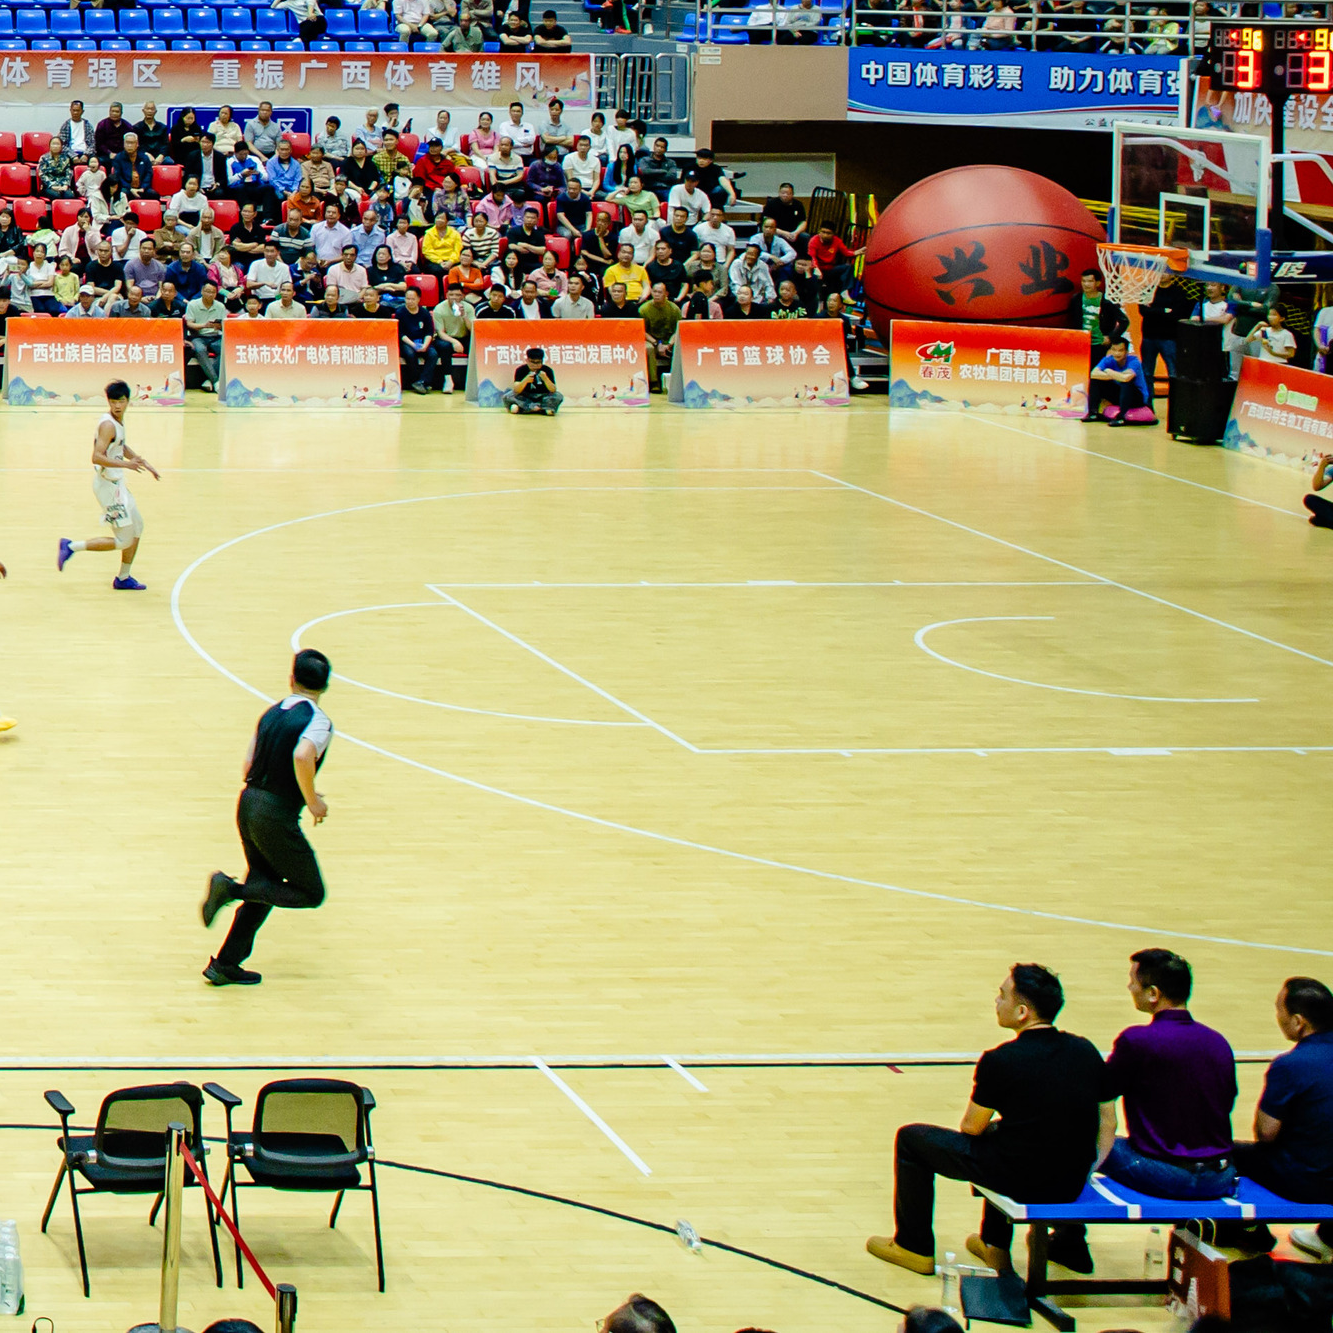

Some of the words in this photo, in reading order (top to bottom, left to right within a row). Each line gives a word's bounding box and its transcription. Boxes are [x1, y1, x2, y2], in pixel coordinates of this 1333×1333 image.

[210, 58, 545, 92] 重振广西体育雄风
[860, 60, 1022, 90] 中国体育彩票
[1237, 50, 1254, 88] 3
[1308, 50, 1331, 90] 3
[934, 239, 1075, 306] 兴业
[17, 342, 175, 365] 广西壮族自治区体育局
[235, 344, 389, 366] 玉林市文化广电体育和旅游局
[696, 344, 831, 367] 广西篮球协会
[985, 348, 1040, 366] 广西春茂
[921, 366, 951, 379] 春茂
[959, 364, 1067, 385] 农牧集团有限公司
